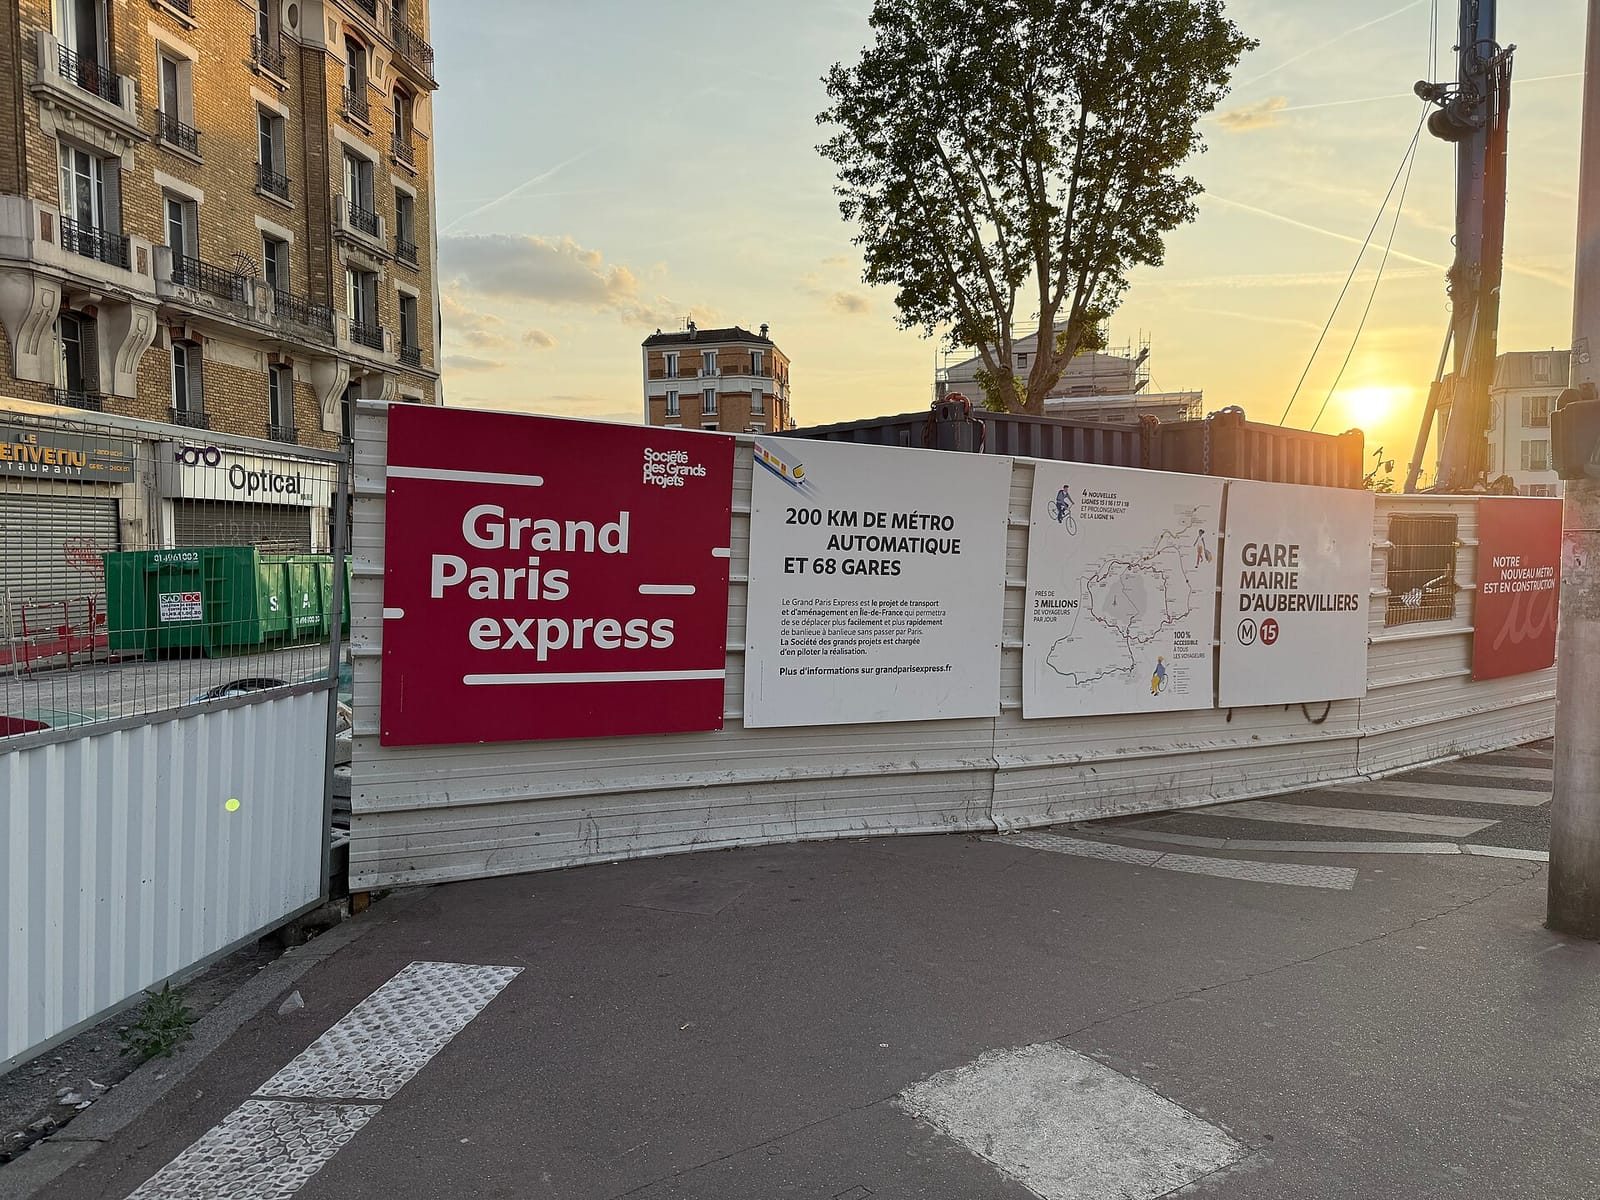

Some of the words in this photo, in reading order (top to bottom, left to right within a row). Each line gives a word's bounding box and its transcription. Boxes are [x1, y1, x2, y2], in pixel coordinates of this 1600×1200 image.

[20, 433, 37, 444] LE
[644, 448, 688, 464] Société
[643, 460, 666, 474] des
[666, 462, 706, 476] Grands
[229, 464, 300, 496] Optical
[642, 472, 684, 488] Projets
[1082, 488, 1088, 496] 4
[1082, 498, 1100, 506] LIGNES
[1088, 506, 1126, 514] PROLONGEMENT
[785, 508, 822, 526] 200
[827, 510, 858, 528] KM
[863, 512, 887, 528] DE
[892, 510, 954, 532] MÉTRO
[462, 504, 630, 554] Grand
[827, 534, 961, 556] AUTOMATIQUE
[1241, 543, 1300, 568] GARE
[1492, 556, 1520, 568] NOTRE
[784, 557, 808, 574] ET
[812, 558, 836, 574] 68
[842, 559, 901, 576] GARES
[1501, 567, 1536, 580] NOUVEAU
[1536, 566, 1554, 578] MÉTRO
[430, 554, 570, 600] Paris
[1240, 571, 1298, 590] MAIRIE
[1483, 582, 1499, 594] EST
[1500, 582, 1510, 592] EN
[1512, 578, 1556, 592] CONSTRUCTION
[270, 596, 278, 612] S
[302, 593, 310, 608] A
[792, 598, 813, 606] Grand
[833, 599, 858, 608] Express
[879, 600, 898, 608] projet
[910, 600, 939, 608] transport
[1034, 600, 1040, 608] 3
[1040, 600, 1078, 608] MILLIONS
[1240, 594, 1358, 612] D'AUBERVILLIERS
[860, 608, 904, 616] Île-de-France
[781, 618, 790, 626] de
[802, 618, 830, 627] déplacer
[832, 618, 846, 627] plus
[848, 618, 883, 626] facilement
[892, 618, 905, 627] plus
[906, 618, 944, 626] rapidement
[468, 617, 676, 662] express
[780, 628, 790, 636] de
[792, 628, 820, 636] banlieue
[822, 628, 826, 636] à
[828, 628, 856, 636] banlieue
[1262, 624, 1276, 640] 15
[780, 638, 788, 646] La
[790, 638, 818, 646] Société
[818, 638, 832, 646] des
[832, 638, 856, 647] grands
[858, 638, 882, 646] projets
[894, 638, 920, 646] chargée
[797, 648, 820, 657] piloter
[780, 667, 798, 676] Plus
[875, 664, 952, 676] grandparisexpress.fr
